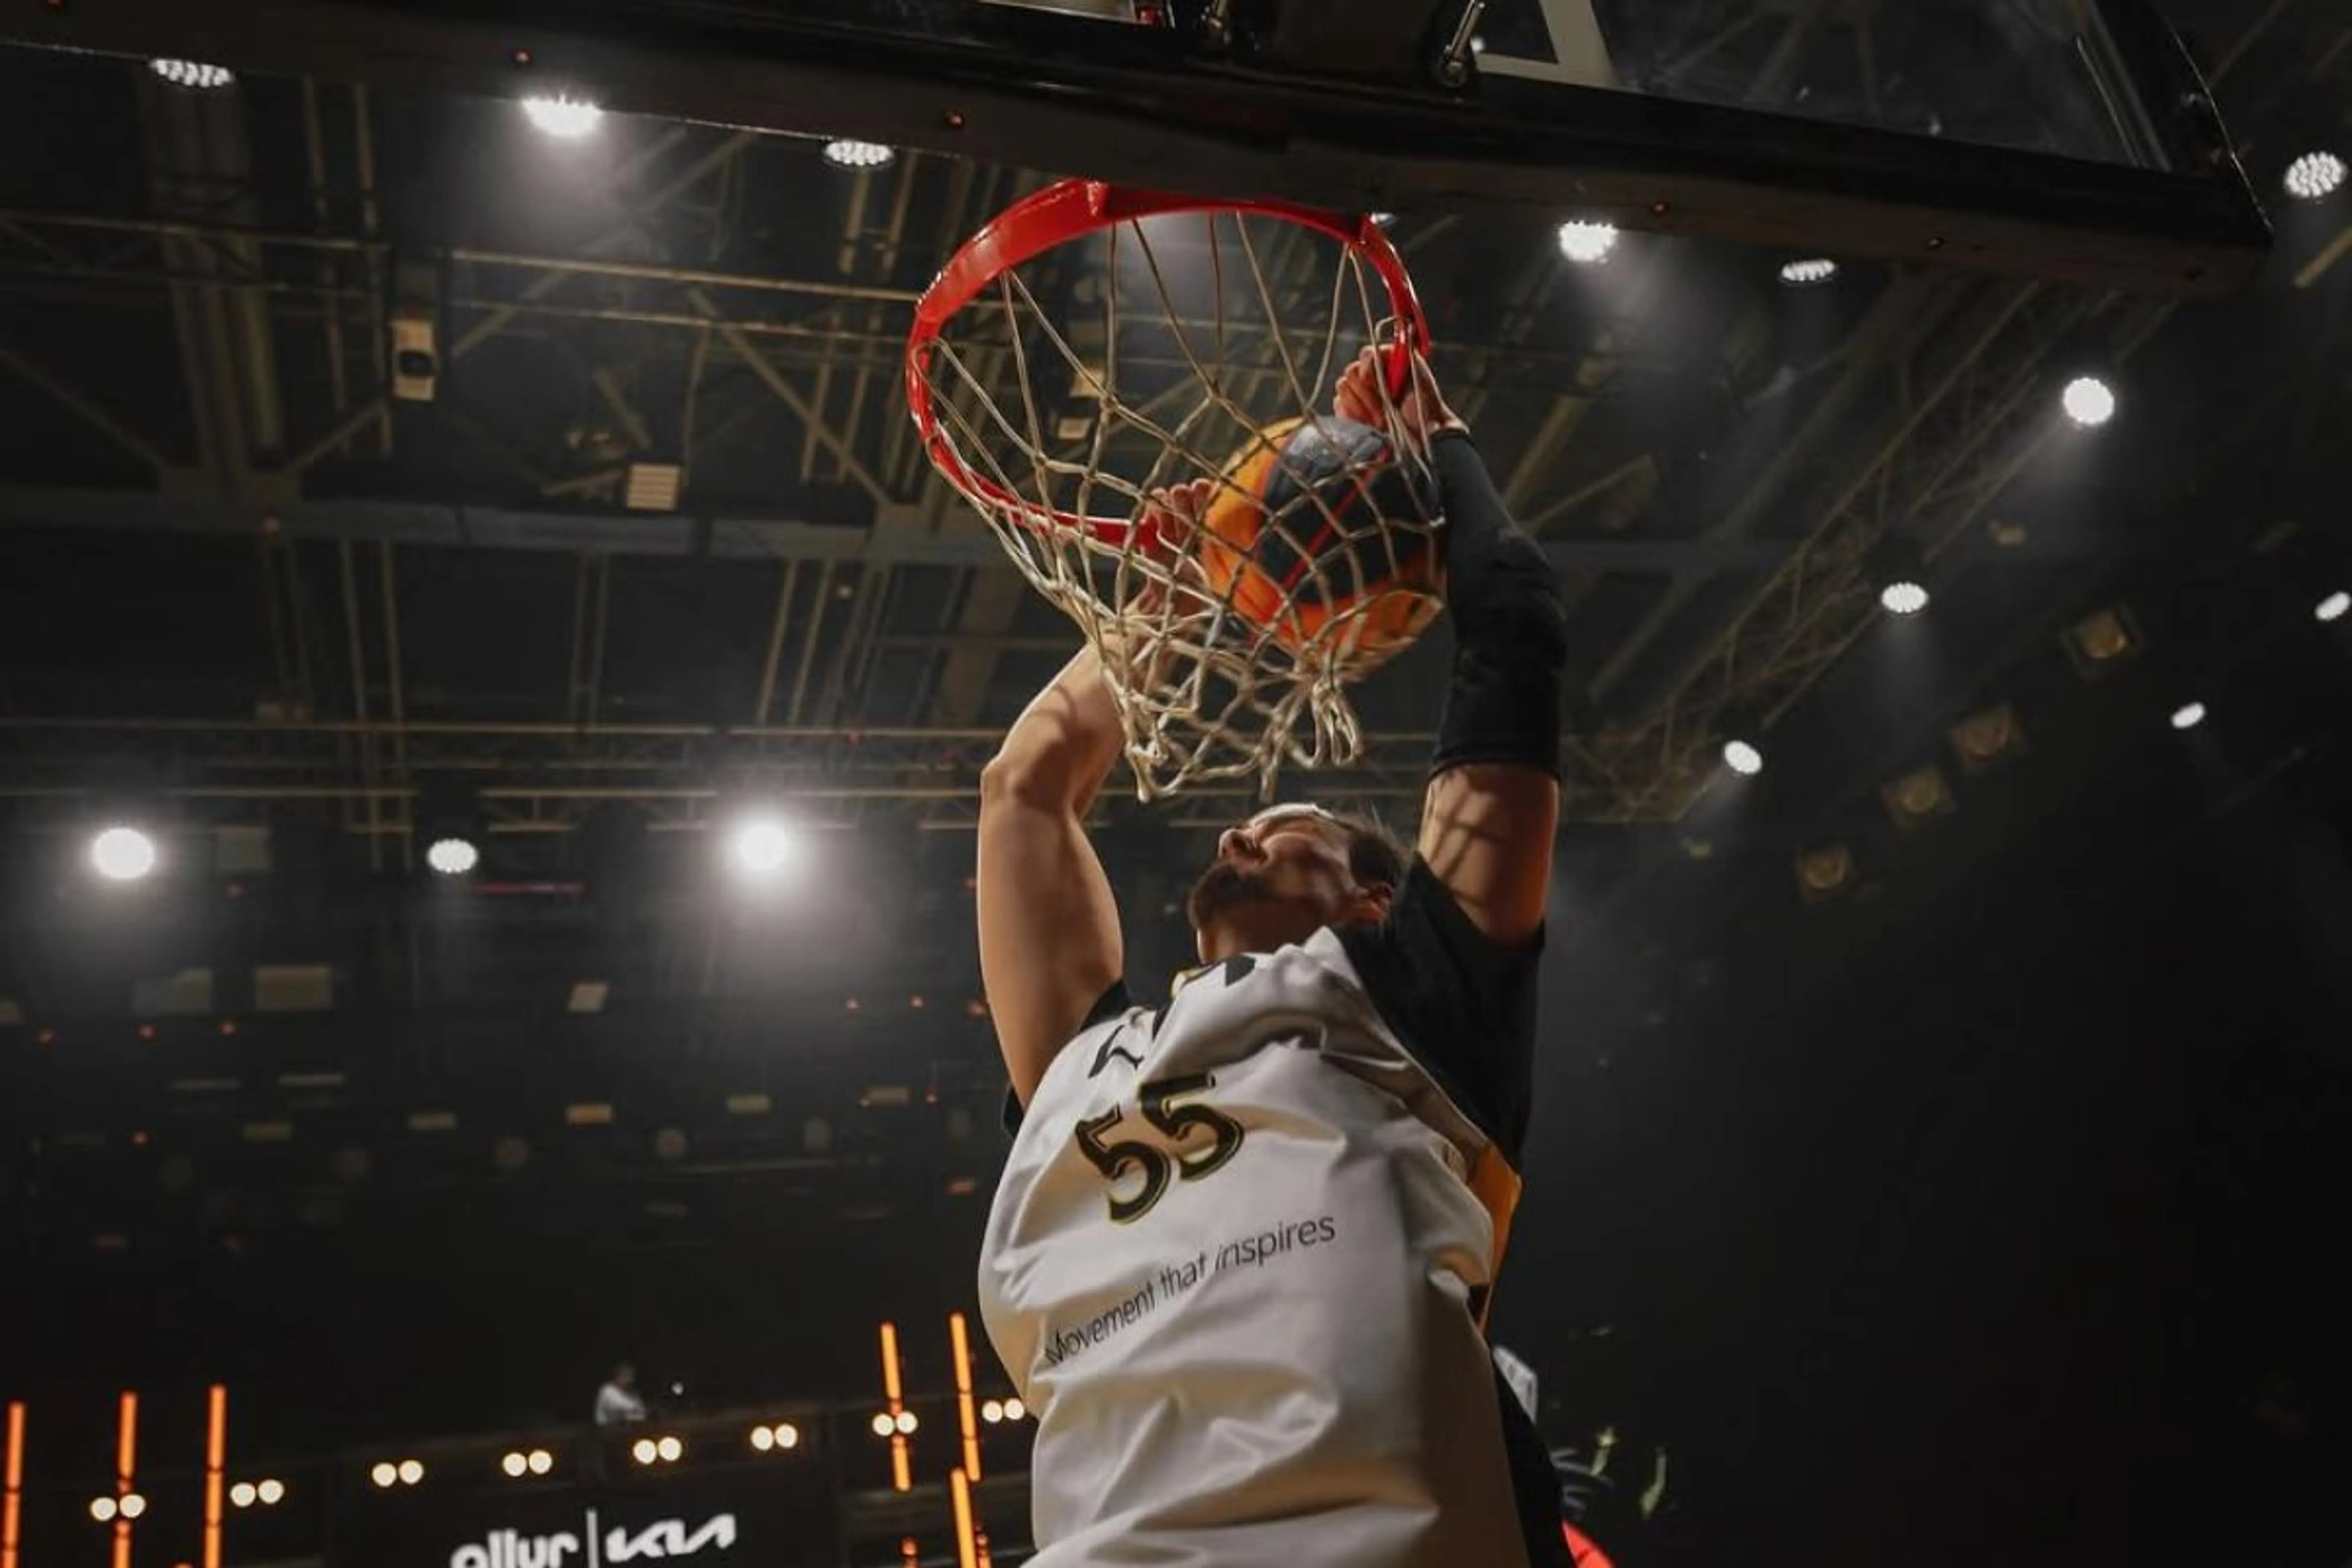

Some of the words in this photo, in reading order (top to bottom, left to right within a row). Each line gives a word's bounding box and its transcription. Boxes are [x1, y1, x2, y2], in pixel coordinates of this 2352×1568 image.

[1074, 1074, 1245, 1225] 55
[1044, 1281, 1156, 1365] Movement
[1159, 1254, 1207, 1301] that
[1215, 1216, 1336, 1272] inspires
